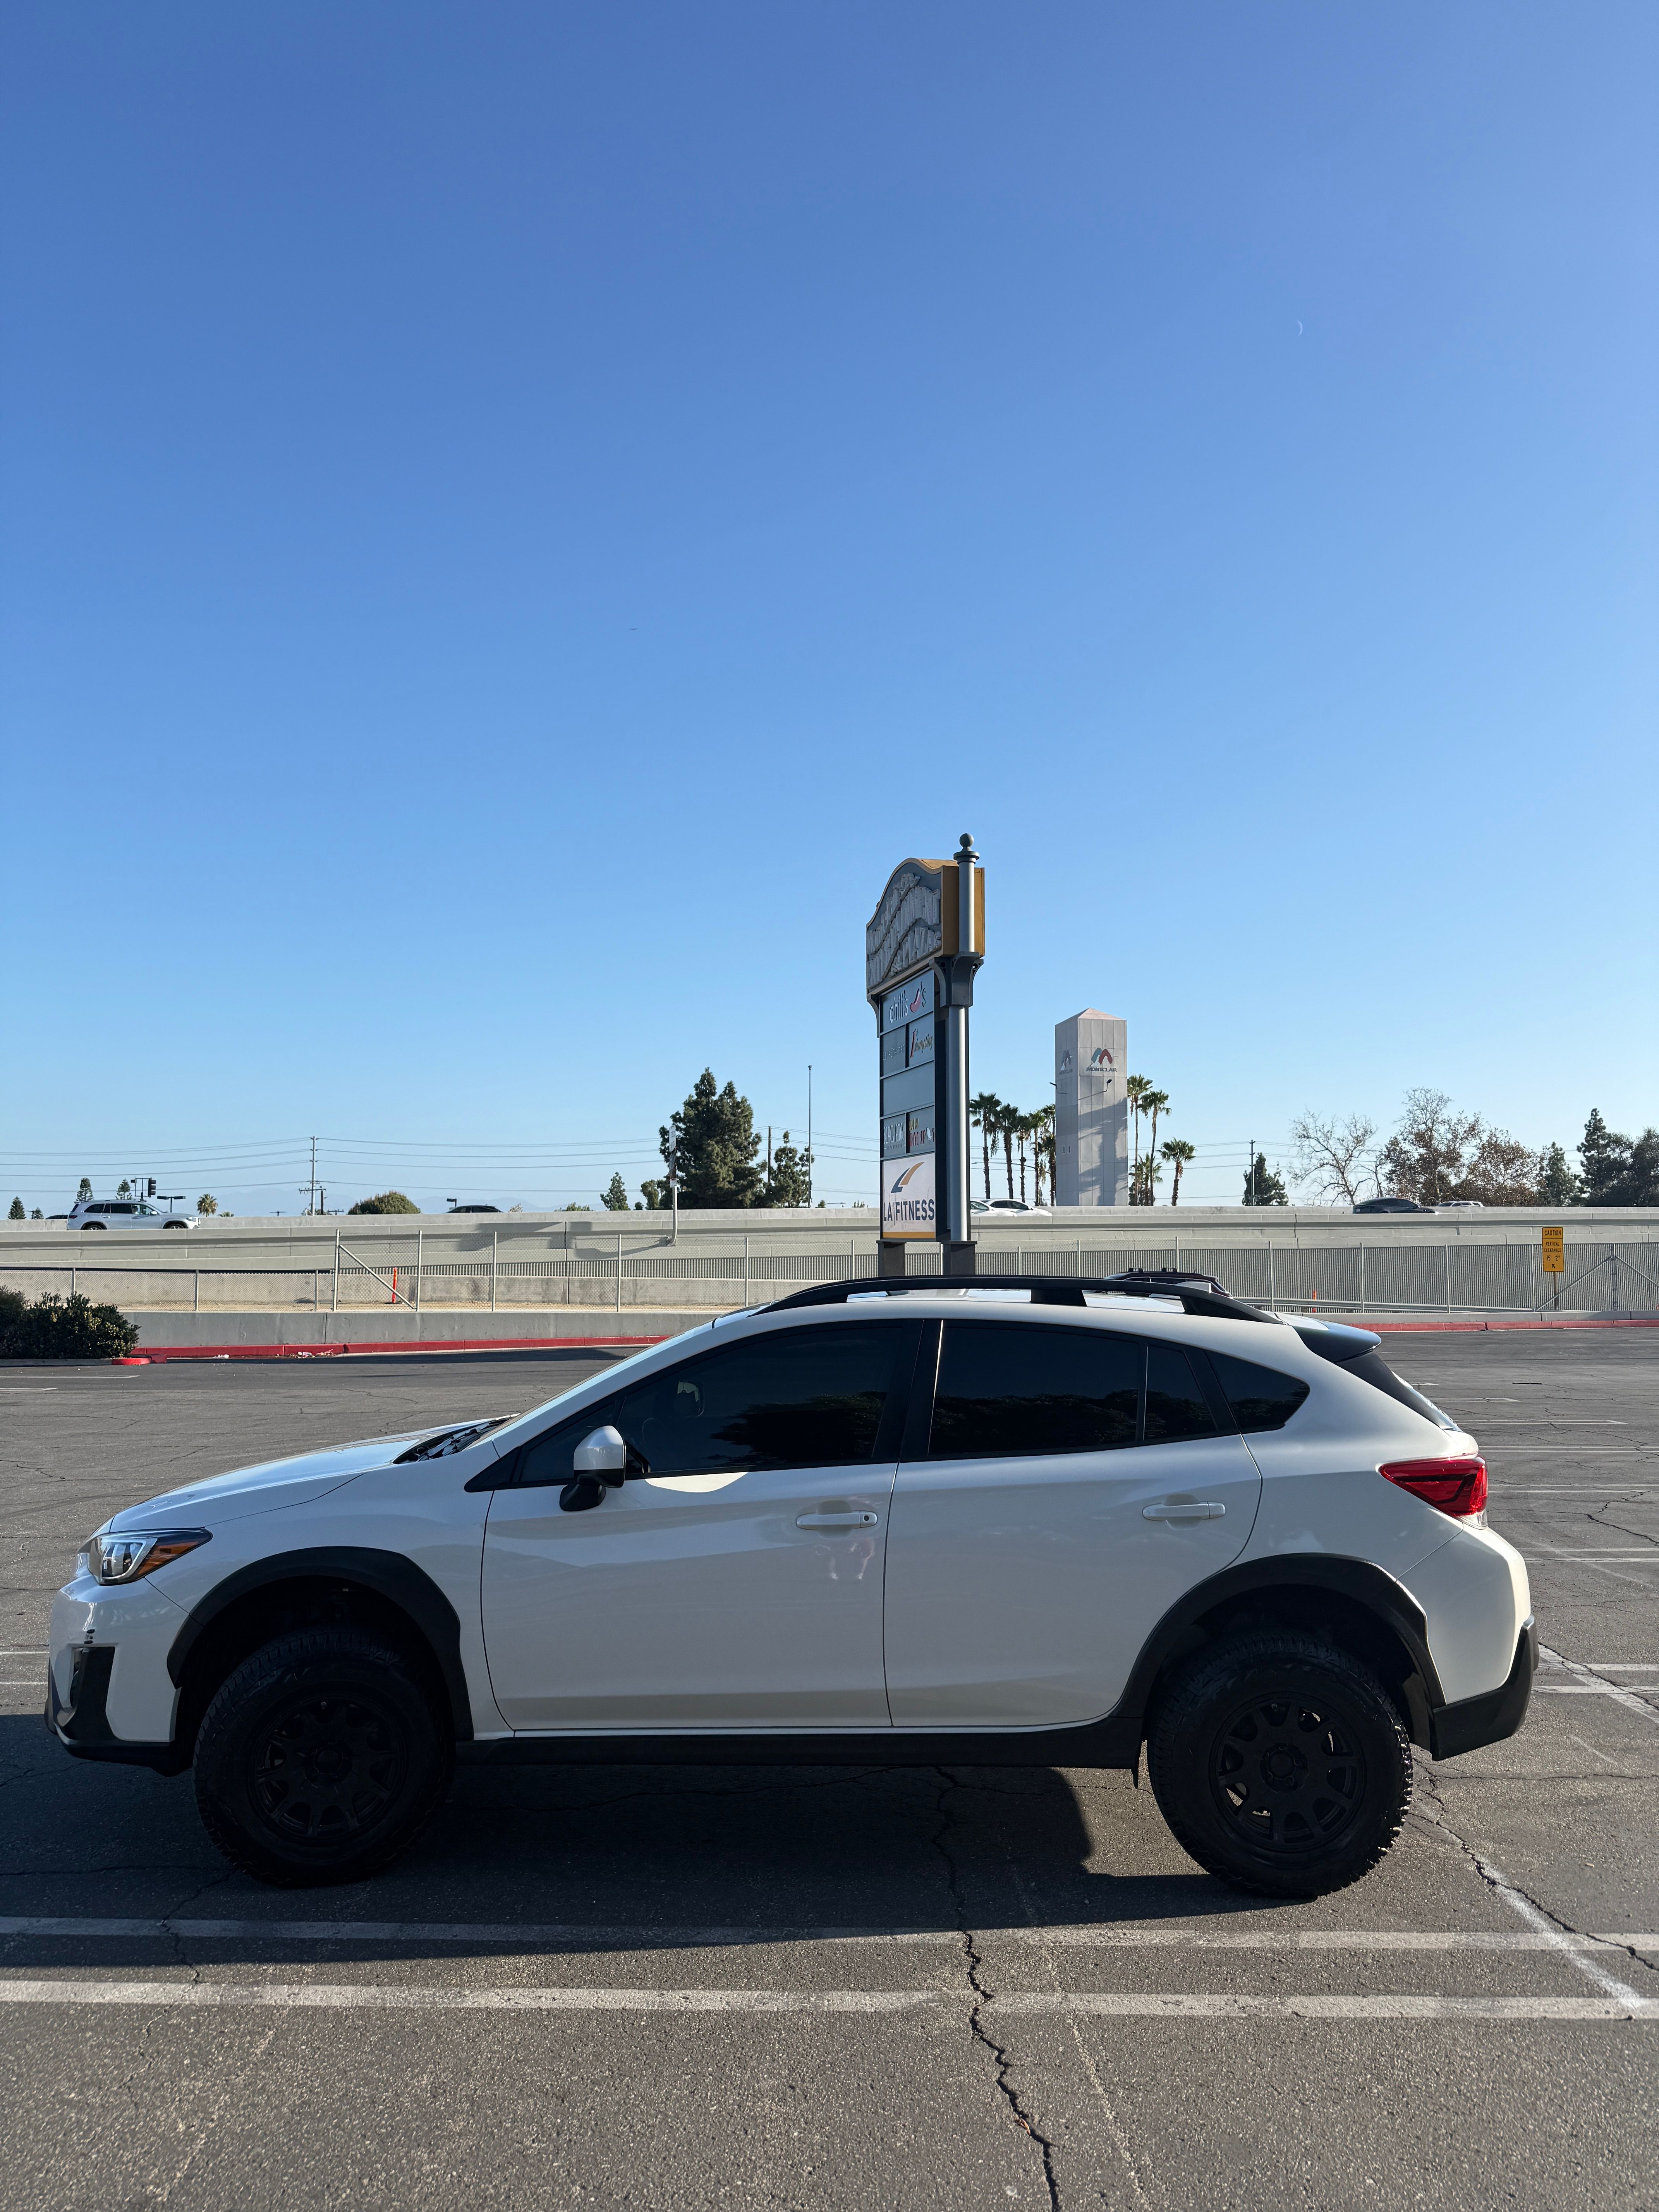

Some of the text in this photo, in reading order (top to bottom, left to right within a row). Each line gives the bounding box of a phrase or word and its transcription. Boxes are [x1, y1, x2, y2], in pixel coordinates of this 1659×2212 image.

[890, 989, 908, 1023] chili's
[914, 1033, 933, 1054] dumpling
[895, 1199, 934, 1221] FITNESS
